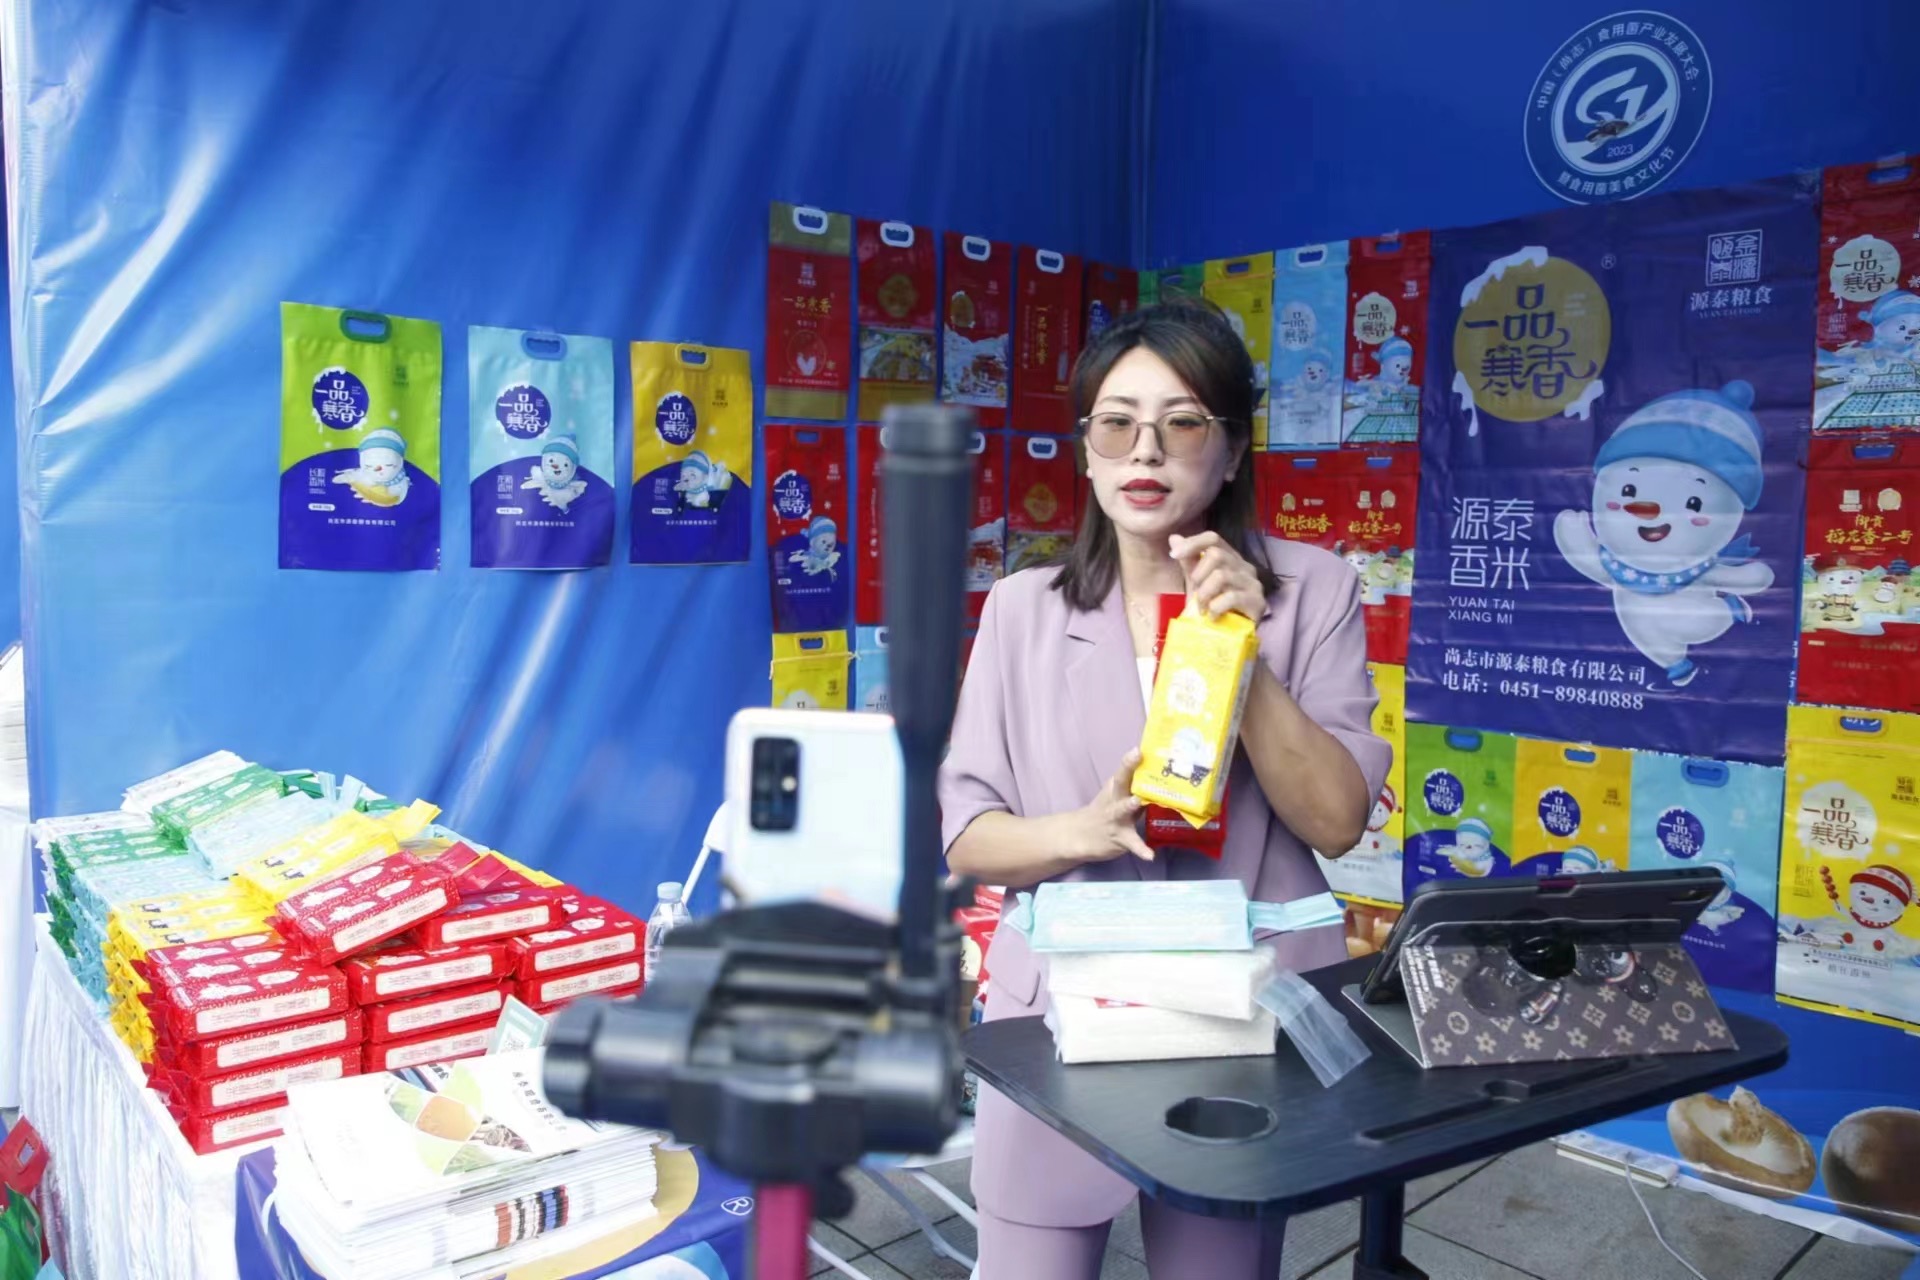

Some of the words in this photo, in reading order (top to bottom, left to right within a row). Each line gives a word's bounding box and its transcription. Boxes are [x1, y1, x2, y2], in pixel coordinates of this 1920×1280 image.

[1606, 144, 1634, 158] 2023
[1690, 286, 1772, 311] 源泰粮食
[1464, 283, 1555, 341] 一品
[314, 379, 349, 401] 一品
[498, 394, 534, 413] 一品
[658, 403, 686, 420] 一品
[1452, 497, 1534, 541] 源泰
[1449, 545, 1531, 590] 香米
[1448, 595, 1487, 609] YUAN
[1493, 598, 1515, 611] TAI
[1448, 609, 1492, 623] XIANG
[1497, 612, 1513, 624] MI
[1444, 647, 1646, 685] 尚志市源泰粮食有限公司
[1802, 797, 1851, 824] 一品
